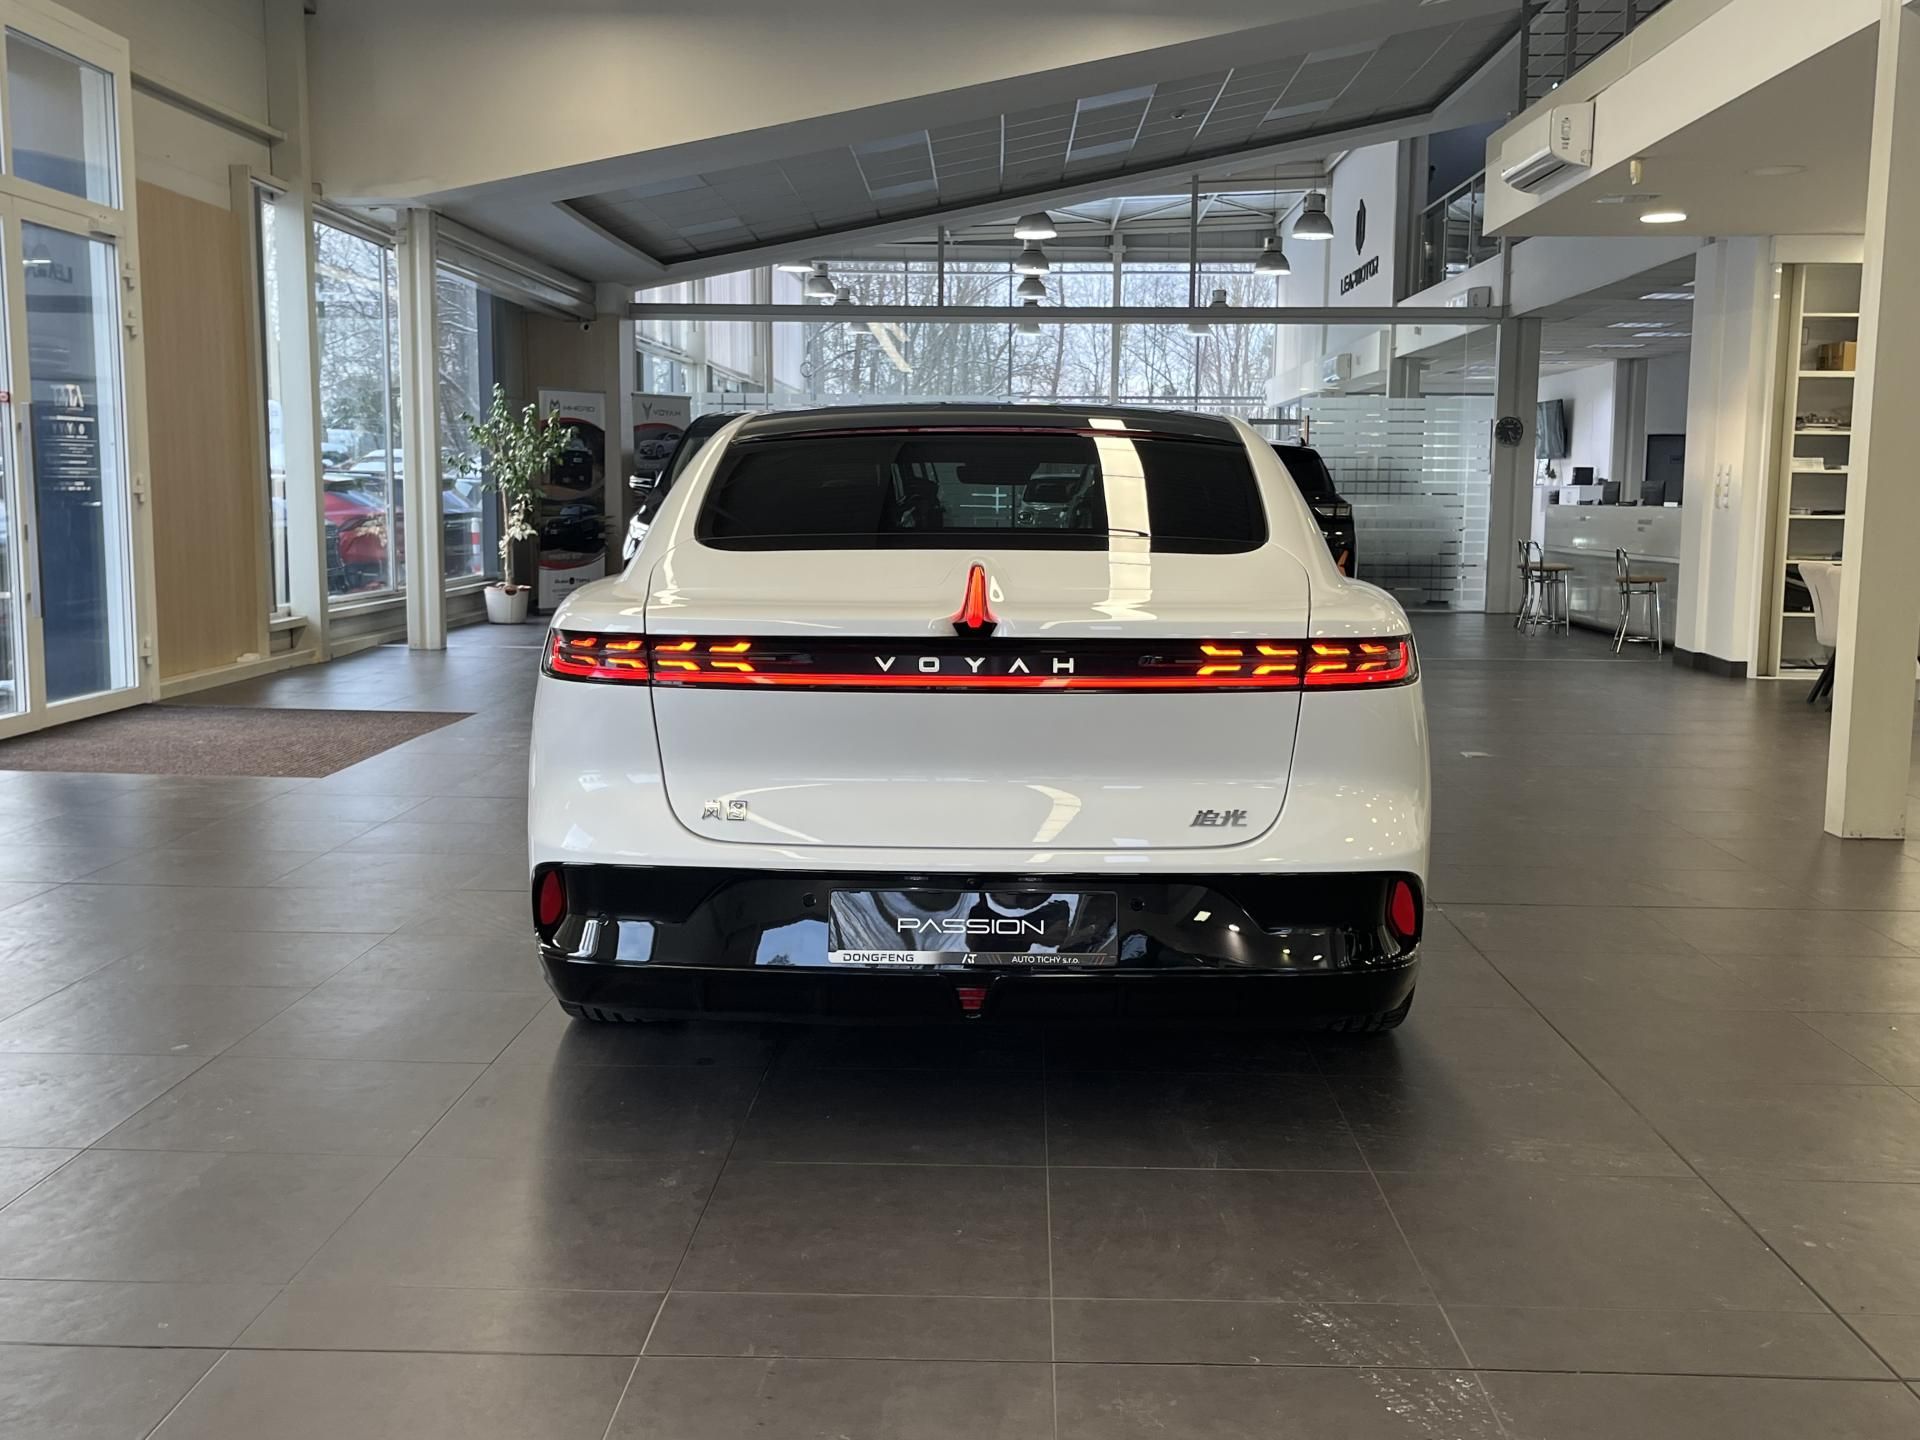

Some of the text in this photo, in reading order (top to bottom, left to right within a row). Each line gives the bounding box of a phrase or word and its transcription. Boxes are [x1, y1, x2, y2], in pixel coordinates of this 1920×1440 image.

[874, 656, 1075, 674] VOYAH
[1189, 809, 1248, 827] 追光
[897, 917, 1045, 935] PASSION
[843, 953, 914, 963] DONGFENG
[1011, 954, 1080, 965] AUTO TICHÝ s.r.o.
